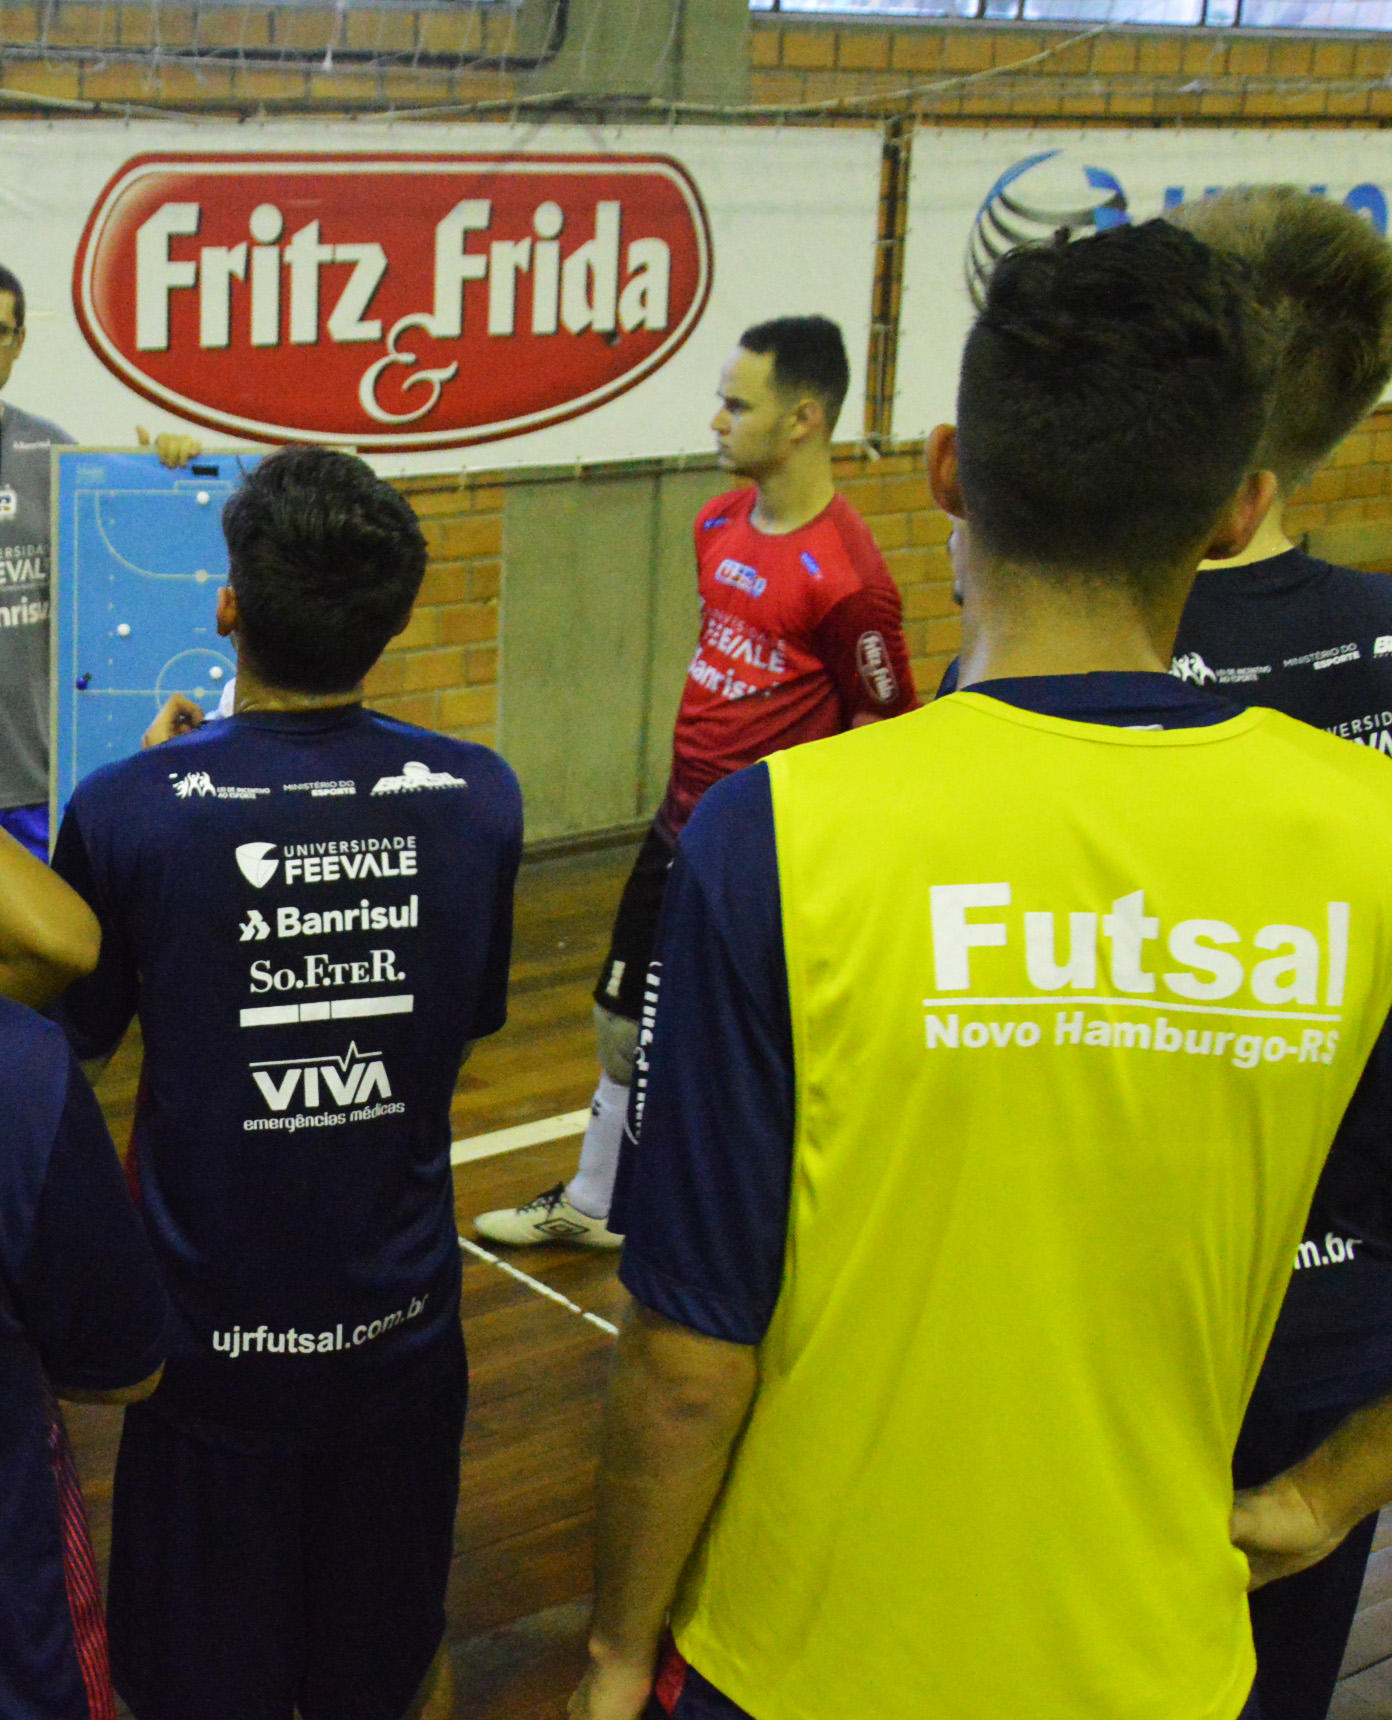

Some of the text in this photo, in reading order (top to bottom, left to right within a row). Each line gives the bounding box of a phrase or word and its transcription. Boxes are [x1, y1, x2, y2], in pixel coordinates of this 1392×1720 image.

[136, 202, 388, 352] Fritz
[430, 199, 672, 338] Frida
[339, 779, 355, 788] DO
[284, 836, 417, 858] UNIVERSIDADE
[285, 851, 418, 885] FEEVALE
[277, 894, 419, 938] Banrisul
[929, 881, 1350, 1006] Futsal
[924, 1010, 1340, 1069] Novo Hamburgo-RS
[252, 1060, 392, 1111] VIVA
[243, 1101, 406, 1132] emergências médicas
[212, 1293, 429, 1358] ujrfutsal.com.br
